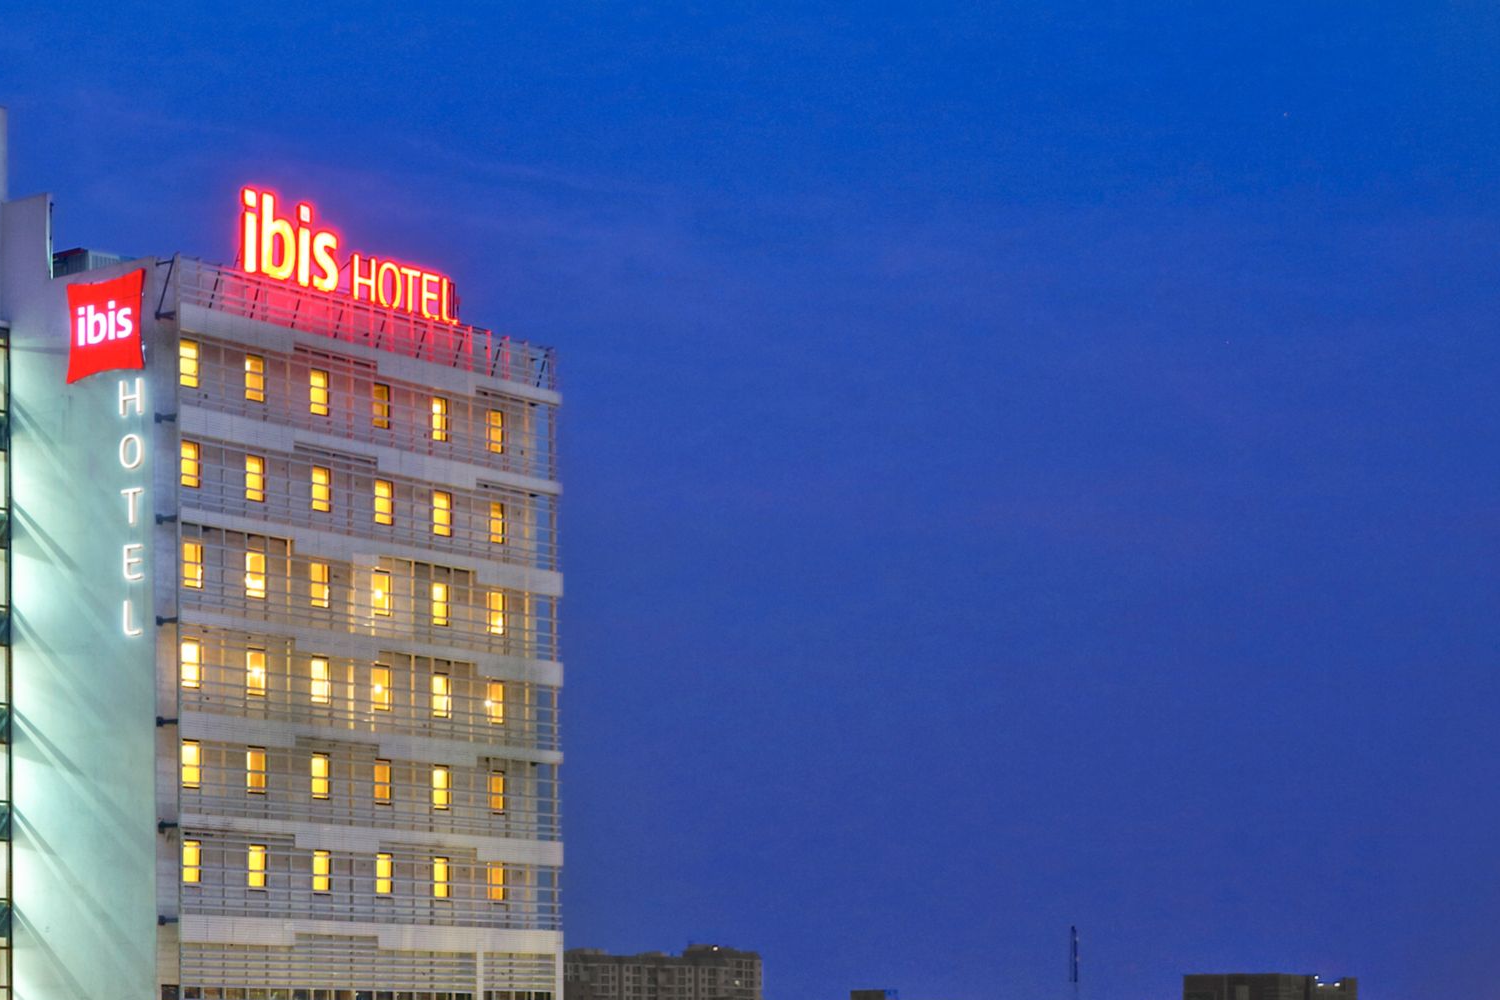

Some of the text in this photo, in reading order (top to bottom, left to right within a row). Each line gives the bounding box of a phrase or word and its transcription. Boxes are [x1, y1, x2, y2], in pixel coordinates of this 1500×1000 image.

[77, 300, 133, 346] ibis
[241, 187, 459, 325] ibis HOTEL
[118, 378, 143, 638] HOTEL
